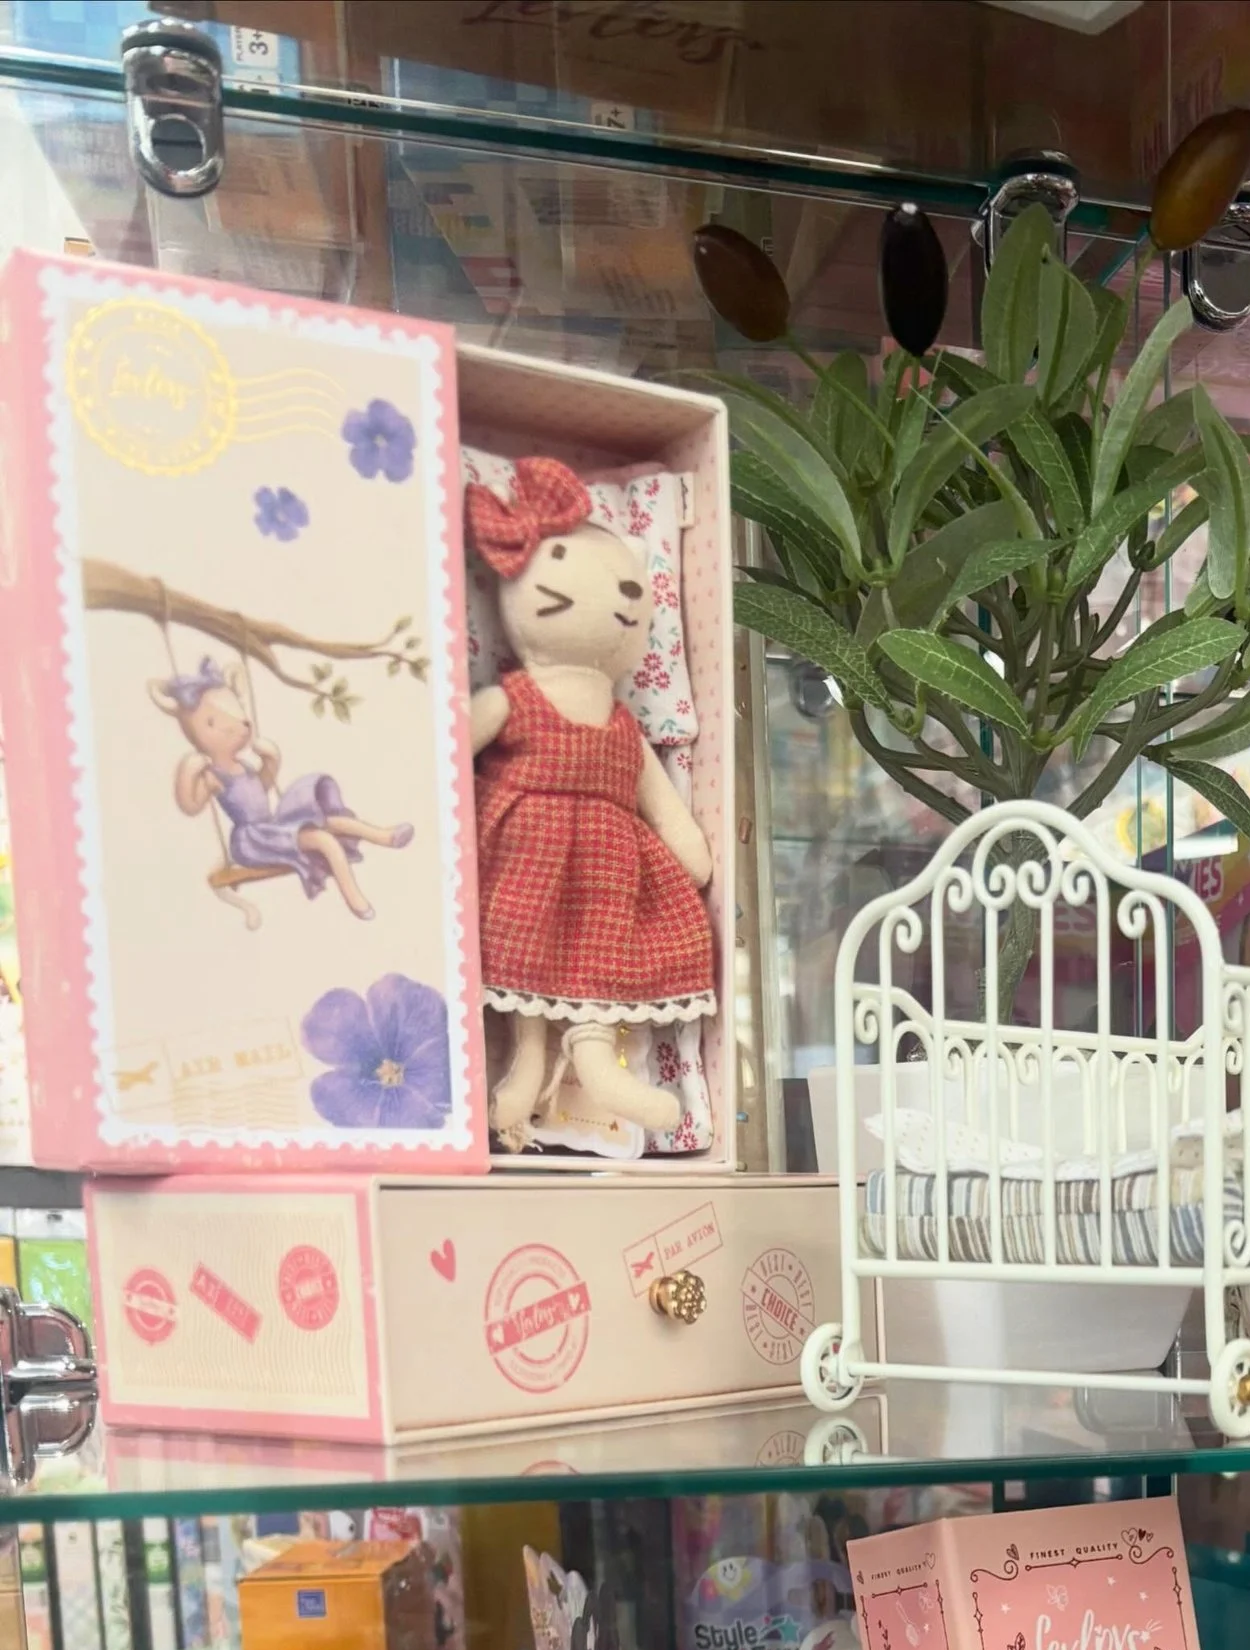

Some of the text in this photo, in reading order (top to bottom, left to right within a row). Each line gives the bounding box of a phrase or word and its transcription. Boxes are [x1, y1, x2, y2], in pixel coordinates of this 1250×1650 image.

[760, 1287, 799, 1332] CHOICE
[1029, 1541, 1119, 1560] FINEST QUALITY
